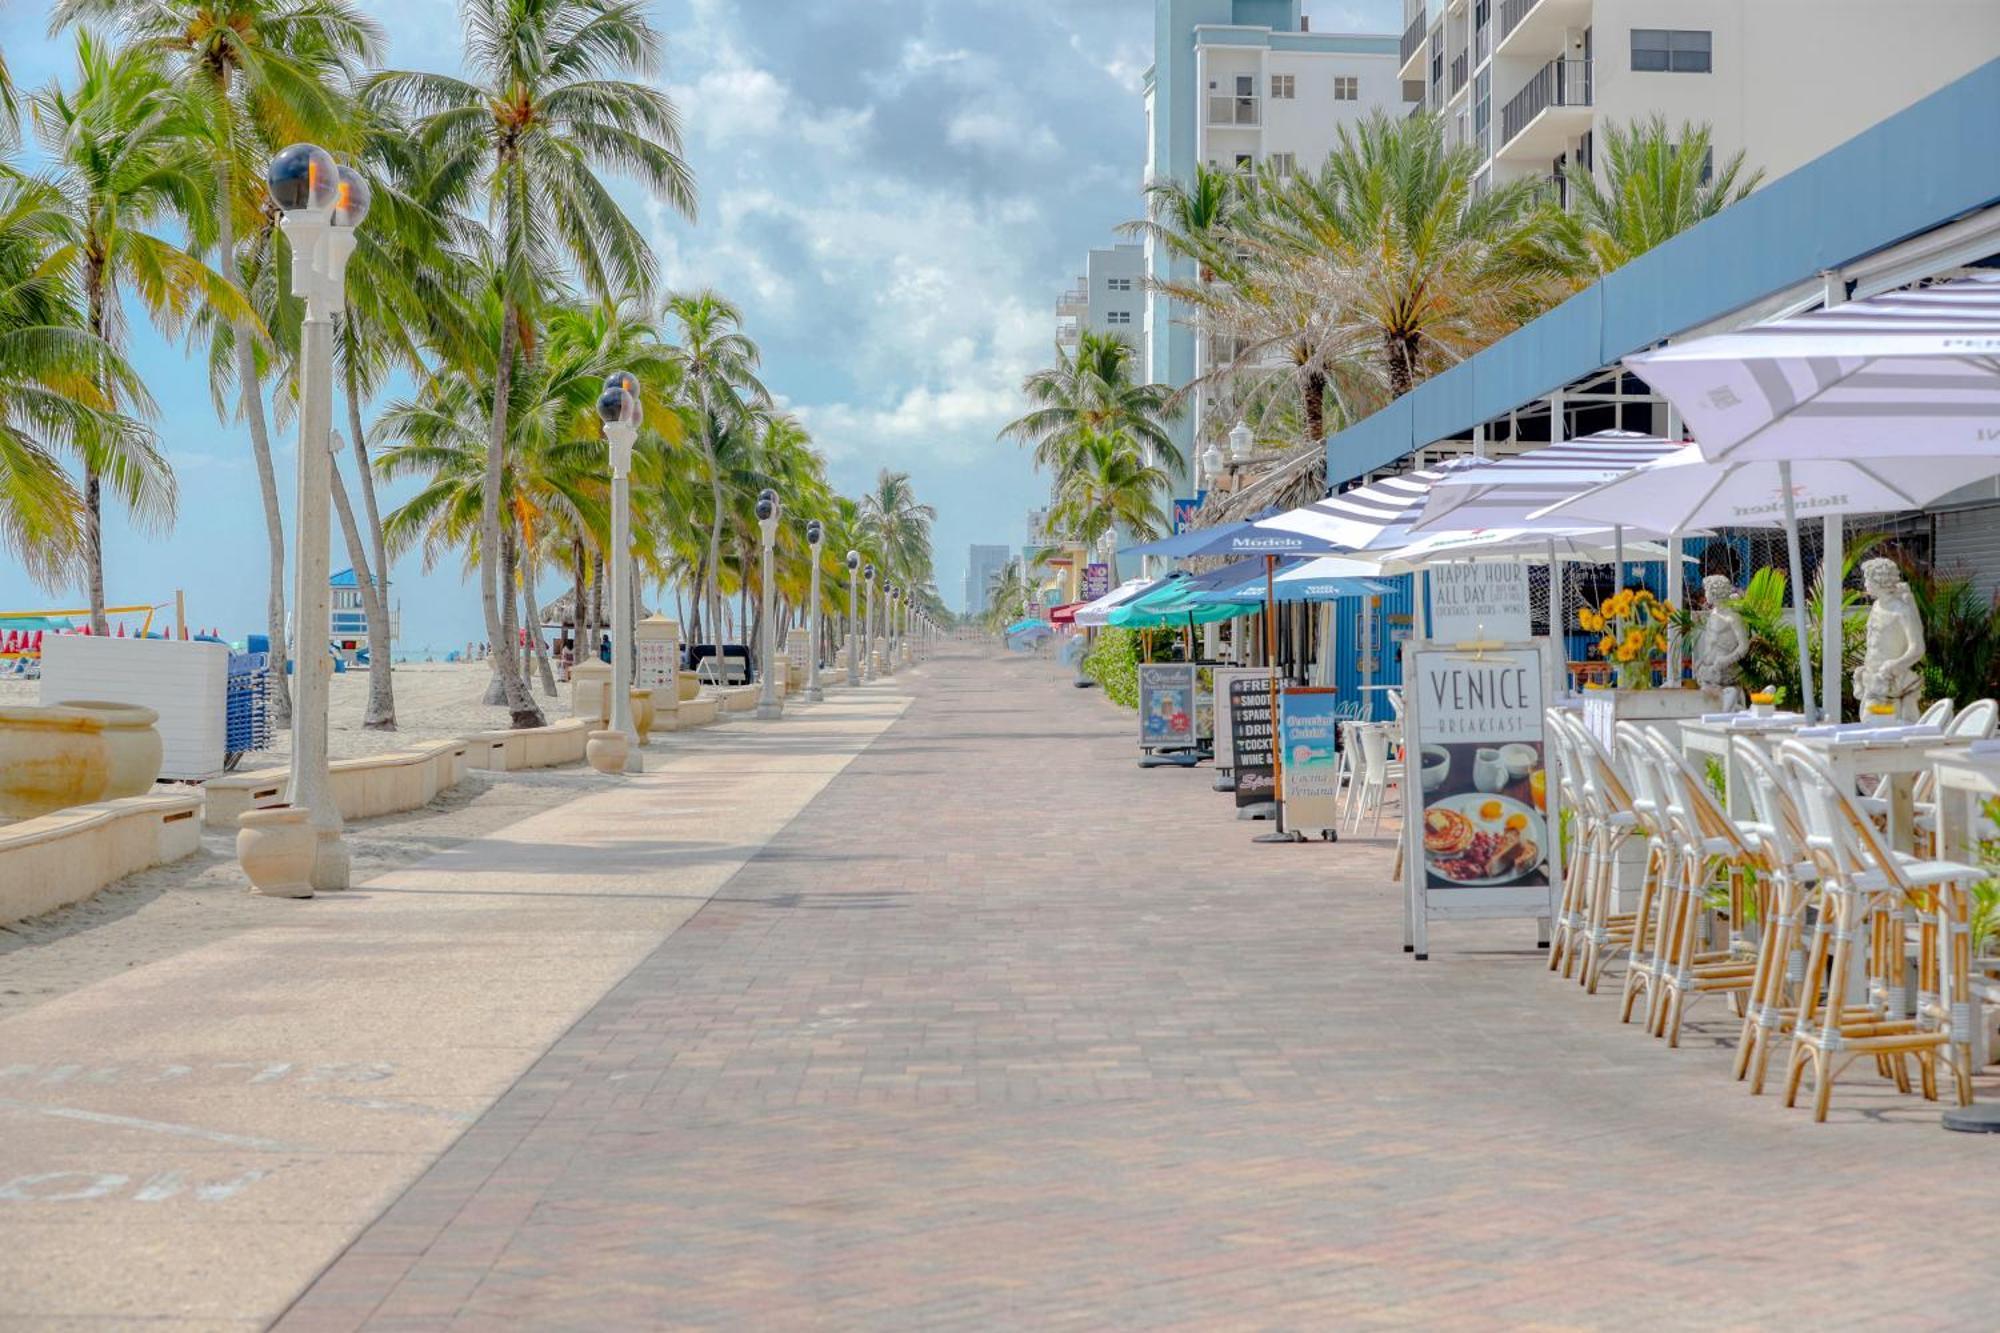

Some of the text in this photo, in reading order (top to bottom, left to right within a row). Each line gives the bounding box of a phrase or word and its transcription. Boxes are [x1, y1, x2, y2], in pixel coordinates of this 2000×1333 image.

[1232, 537, 1302, 547] Modelo
[1436, 563, 1521, 584] HAPPY HOUR
[1438, 587, 1458, 604] ALL
[1464, 585, 1486, 603] DAY
[1243, 681, 1289, 691] FREH
[1430, 669, 1528, 710] VENICE
[1241, 695, 1271, 706] SMOOT
[1242, 709, 1271, 721] SPARK
[1246, 724, 1273, 736] DRIN
[1439, 717, 1522, 733] BREAKFAST
[1245, 740, 1273, 751] COCKT
[1240, 754, 1264, 766] WINE
